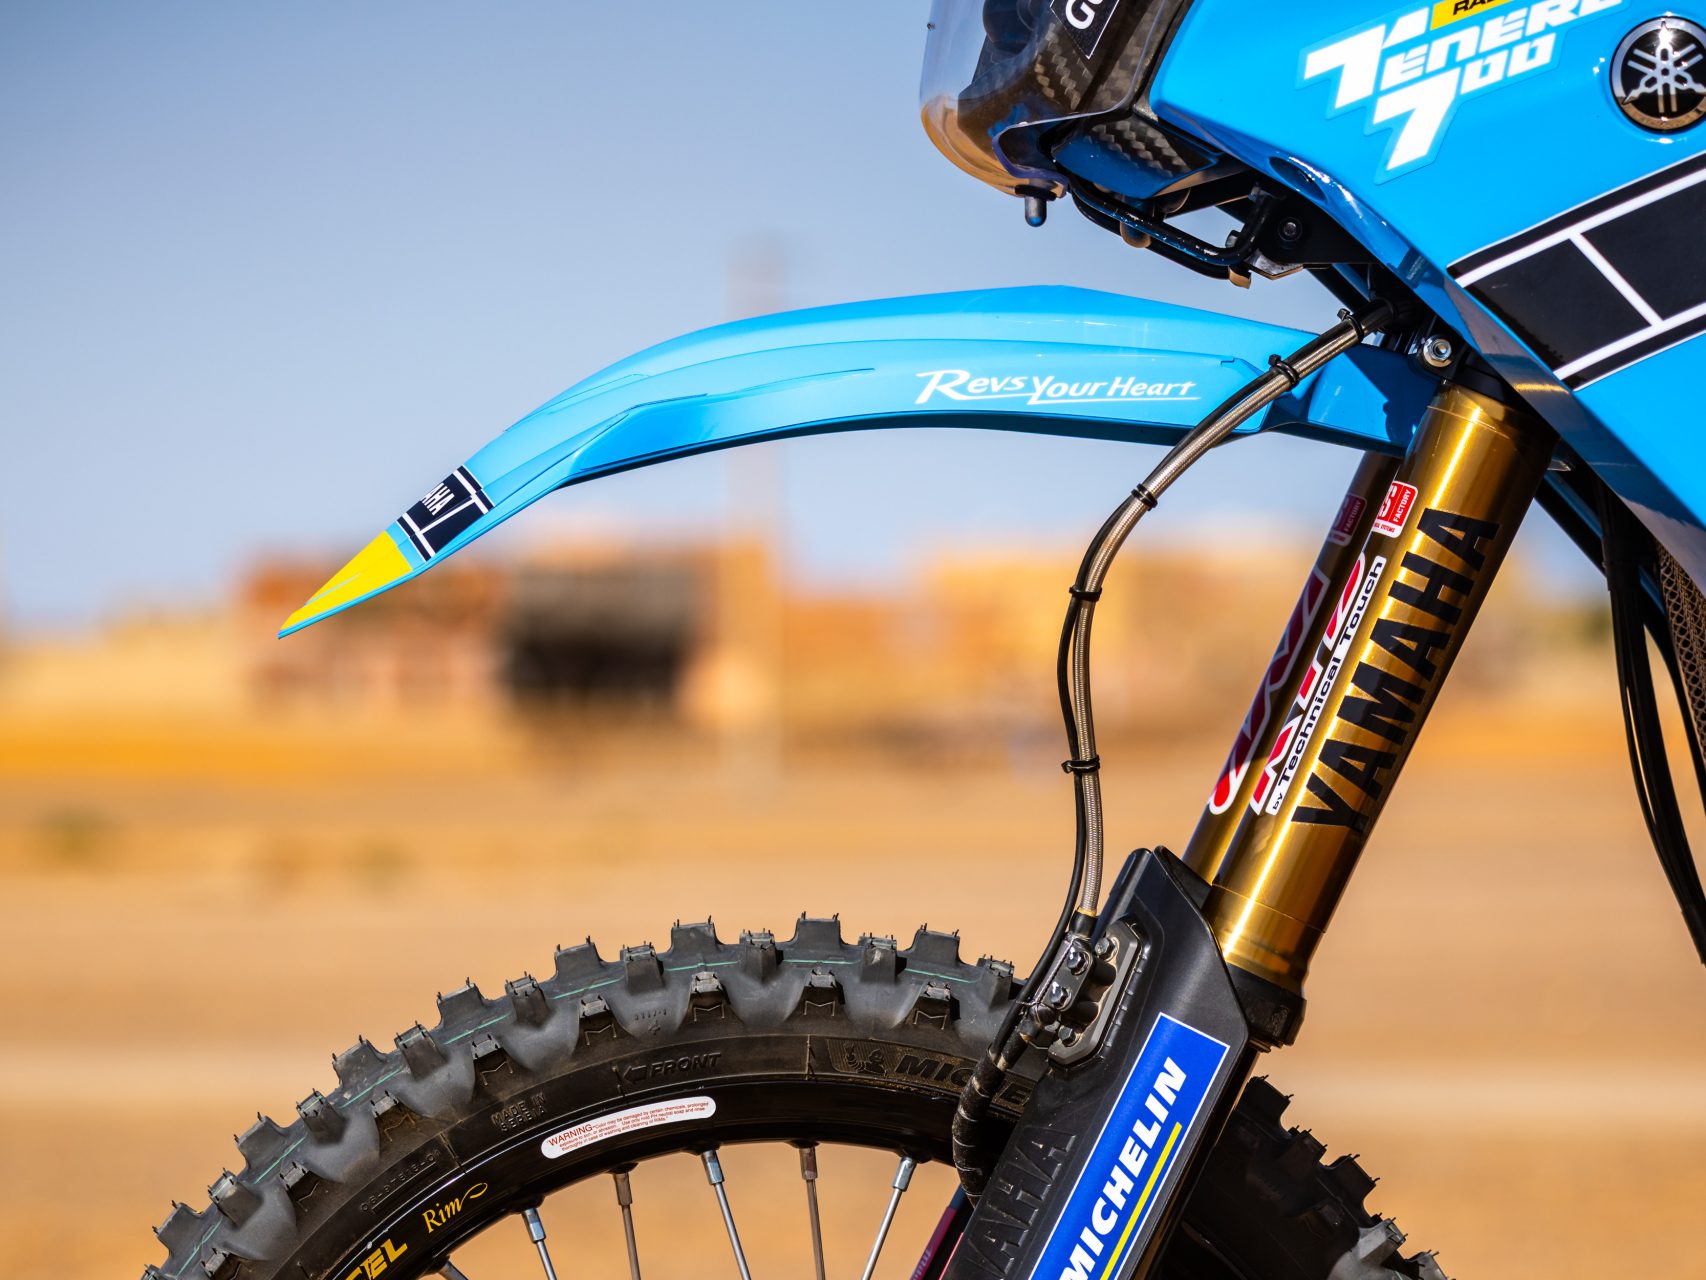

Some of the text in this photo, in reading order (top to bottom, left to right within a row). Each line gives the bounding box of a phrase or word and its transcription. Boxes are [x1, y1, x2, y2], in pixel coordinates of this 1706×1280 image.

[1304, 0, 1622, 109] TENER
[1373, 32, 1555, 170] 700
[914, 369, 1197, 405] Revs Your Heart
[1393, 489, 1412, 522] FACTORY
[1271, 562, 1383, 811] by Technical Touch
[1291, 507, 1499, 834] YAMAHA
[648, 1051, 721, 1078] FRONT
[422, 1182, 488, 1233] Rim
